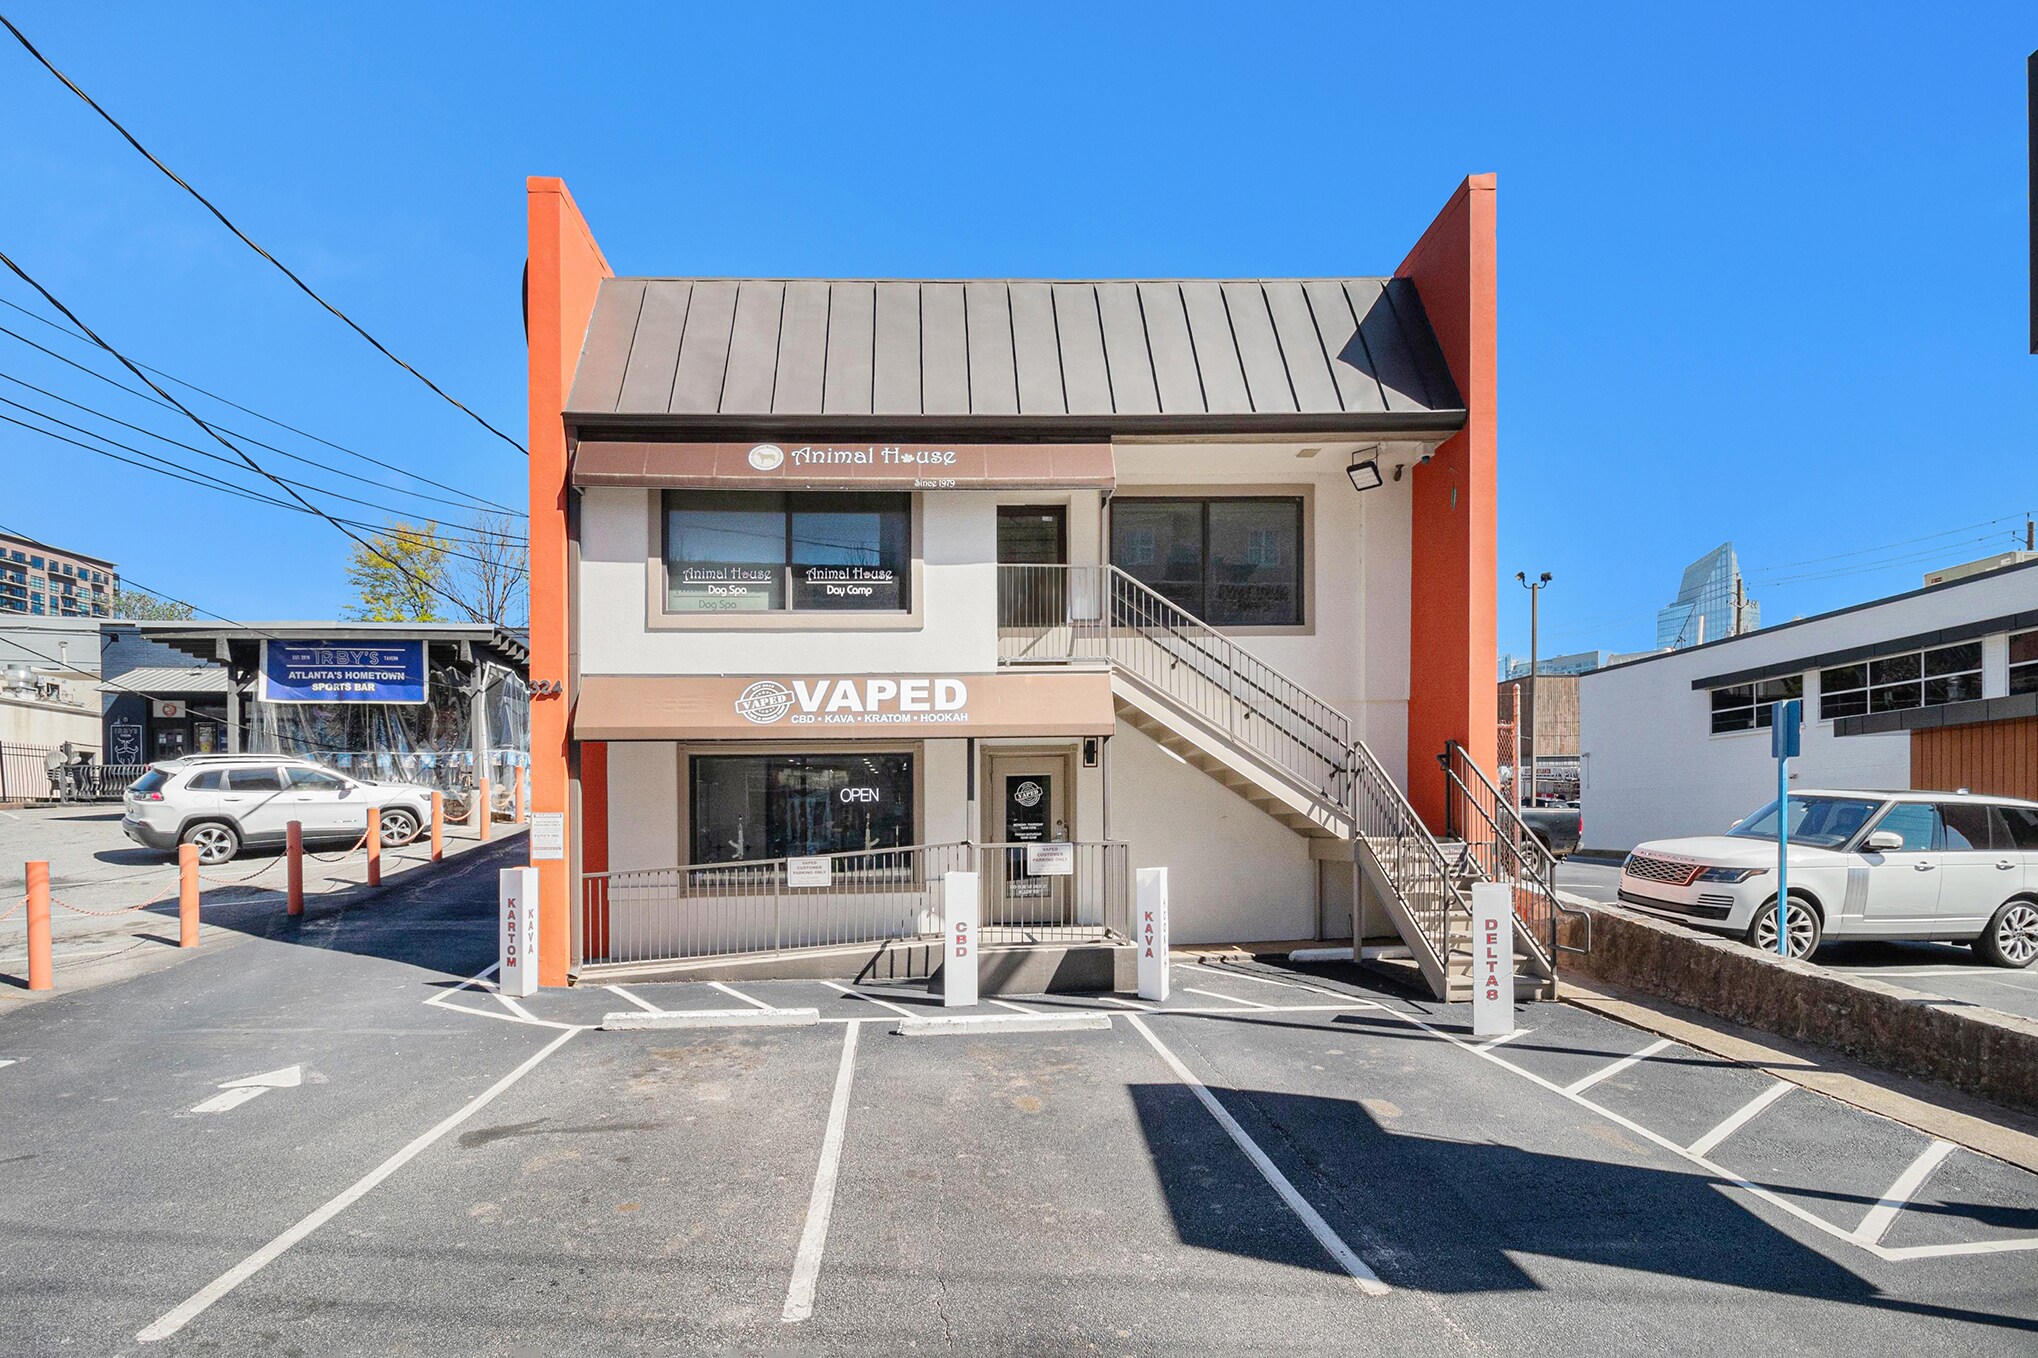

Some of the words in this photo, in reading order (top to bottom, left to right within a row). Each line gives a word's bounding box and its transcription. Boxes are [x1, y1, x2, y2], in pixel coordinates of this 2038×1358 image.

[791, 447, 874, 466] Animal
[914, 478, 937, 488] Since
[938, 479, 956, 488] 1979
[683, 567, 728, 581] Animal
[806, 567, 850, 581] Animal
[708, 585, 727, 597] Dog
[729, 585, 747, 597] Spa
[826, 585, 845, 597] Day
[846, 585, 873, 597] Camp
[314, 651, 379, 665] IRBY'S
[288, 671, 343, 680] ATLANTA'S
[345, 671, 406, 680] HOMETOWN
[311, 683, 352, 692] SPORTS
[354, 683, 376, 692] BAR
[529, 679, 563, 695] 324
[742, 695, 787, 710] VAPED
[792, 679, 968, 712] VAPED
[791, 714, 815, 724] CBD
[824, 714, 855, 723] KAVA
[864, 714, 911, 723] KRATOM
[920, 713, 968, 722] HOOKAH
[840, 788, 880, 803] OPEN
[506, 898, 517, 968] KARTOM
[955, 921, 968, 958] CBD
[1144, 911, 1154, 958] KAVA
